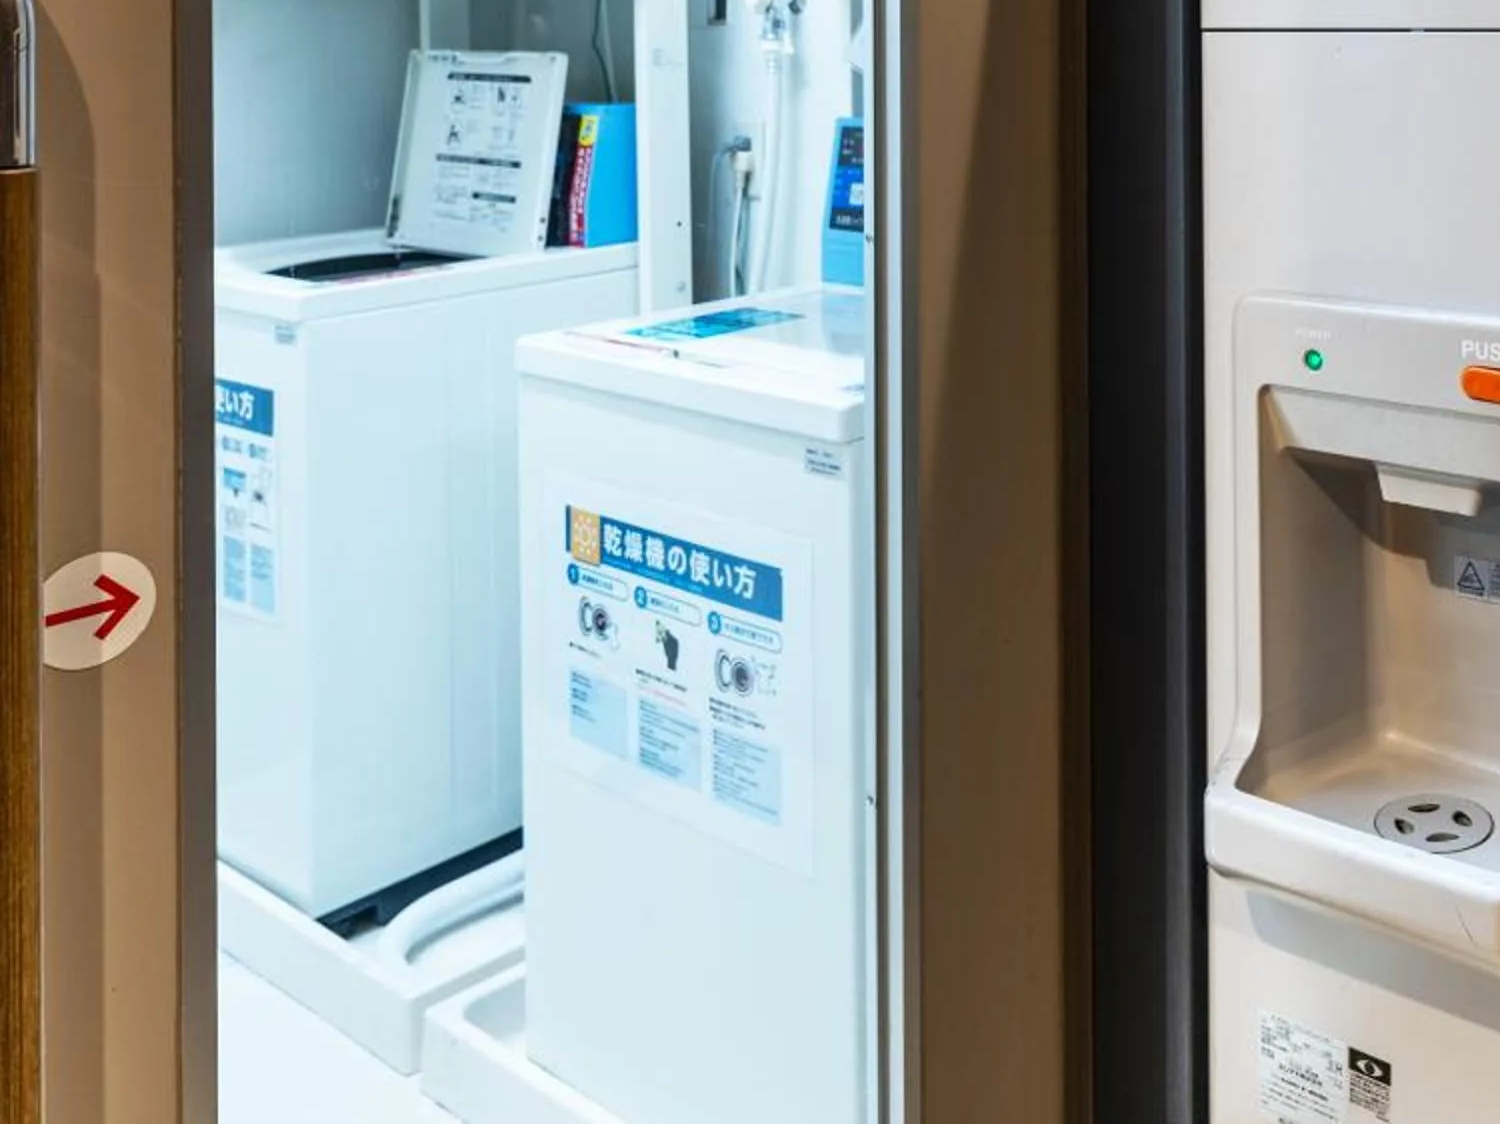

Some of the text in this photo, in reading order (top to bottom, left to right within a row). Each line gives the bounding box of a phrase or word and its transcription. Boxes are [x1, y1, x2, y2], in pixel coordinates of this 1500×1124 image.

[603, 522, 757, 599] 乾燥機の使い方
